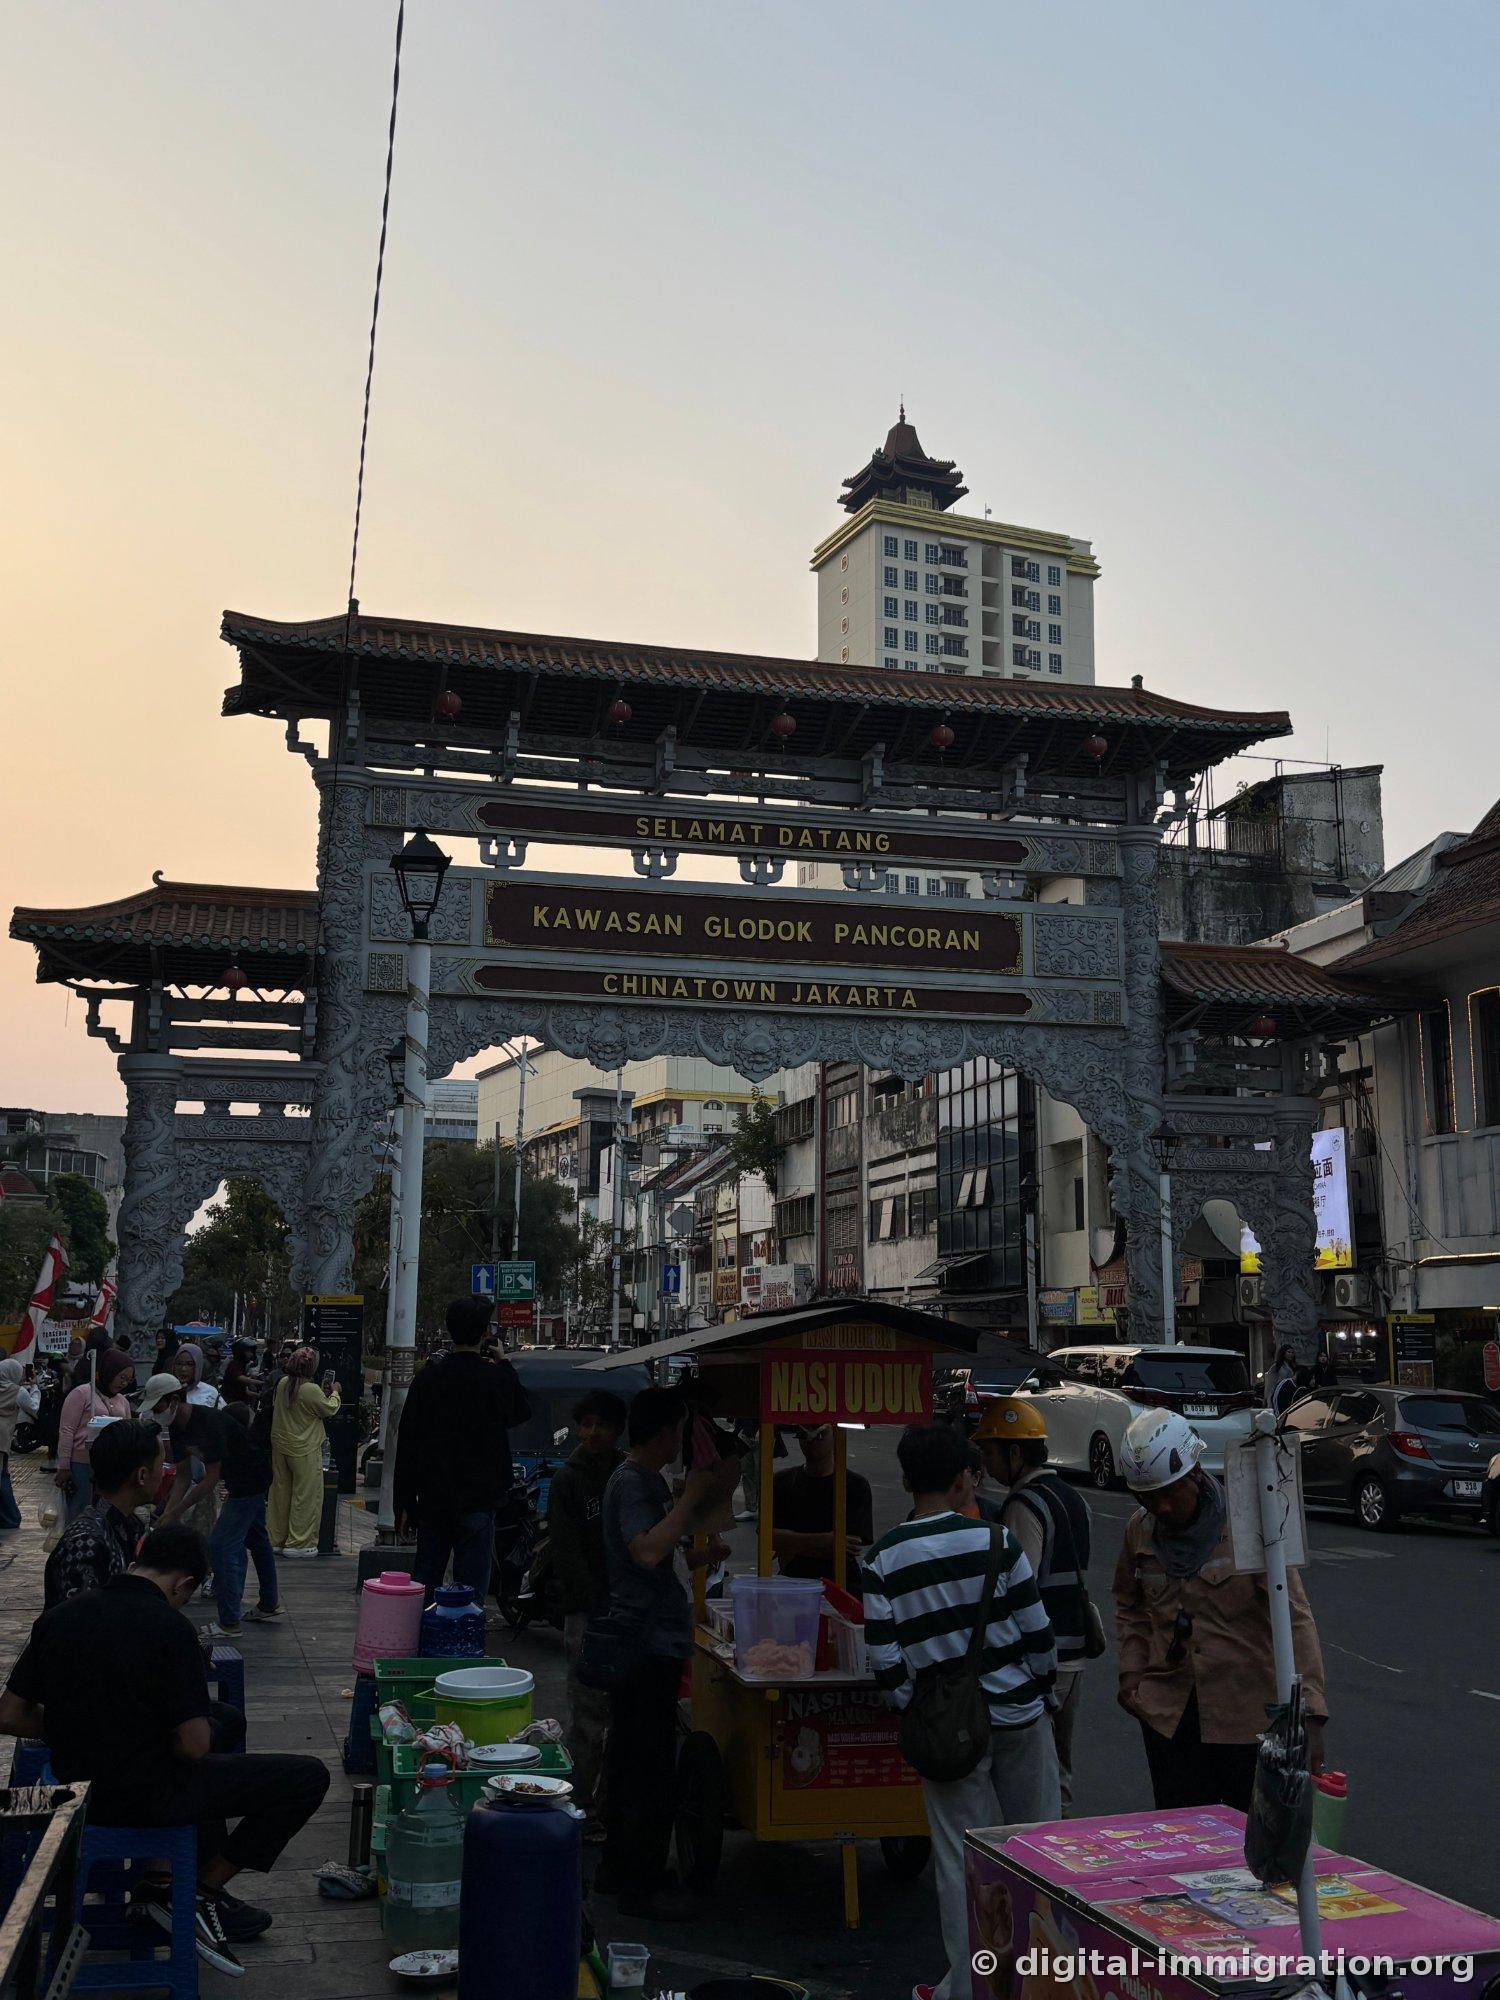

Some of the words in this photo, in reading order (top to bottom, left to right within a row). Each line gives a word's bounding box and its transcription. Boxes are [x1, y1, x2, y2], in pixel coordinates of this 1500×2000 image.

[636, 817, 763, 846] SELAMAT
[778, 828, 891, 853] DATANG
[532, 905, 683, 936] KAWASAN
[704, 915, 814, 944] GLODOK
[834, 923, 981, 951] PANCORAN
[603, 974, 776, 1002] CHINATOWN
[791, 982, 919, 1008] JAKARTA
[806, 1326, 834, 1348] NASI
[838, 1325, 874, 1349] UDUK
[770, 1361, 837, 1413] NASI
[844, 1362, 924, 1414] UDUK
[786, 1690, 842, 1720] NASI
